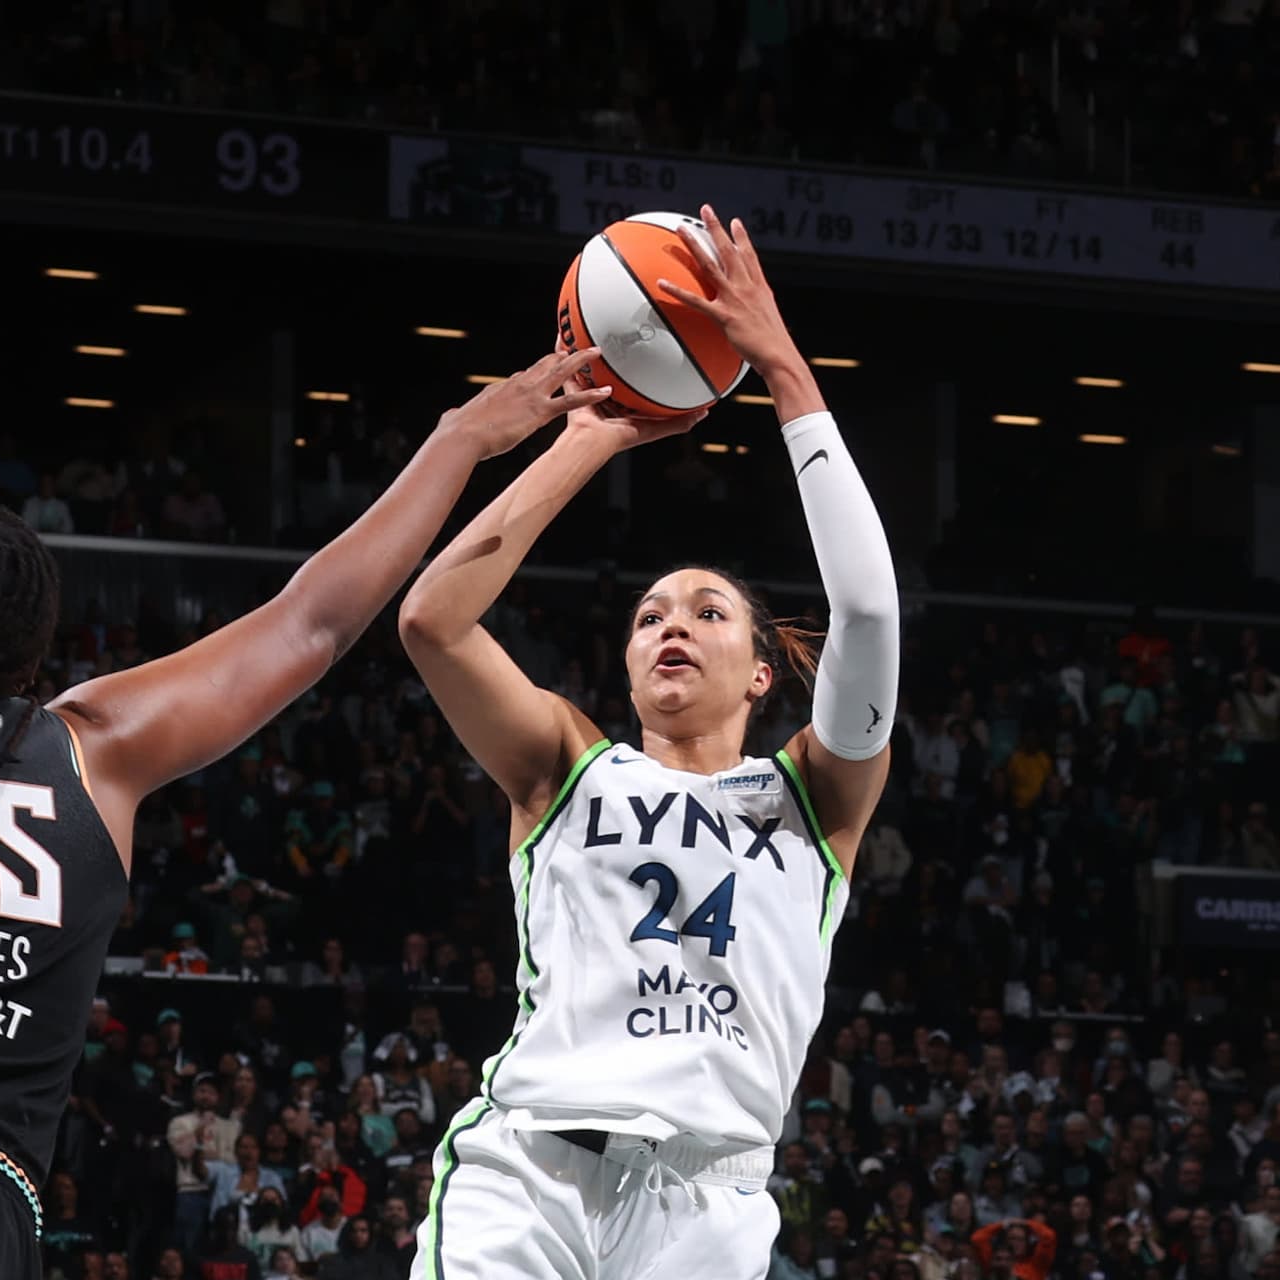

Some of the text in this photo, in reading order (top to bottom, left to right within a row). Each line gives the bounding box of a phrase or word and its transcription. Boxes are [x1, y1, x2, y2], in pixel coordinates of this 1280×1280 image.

[52, 126, 153, 173] 10.4
[216, 128, 302, 197] 93
[1152, 208, 1205, 235] REB
[1159, 241, 1196, 270] 44
[584, 792, 785, 872] LYNX
[629, 861, 736, 958] 24
[638, 965, 738, 1015] MAO
